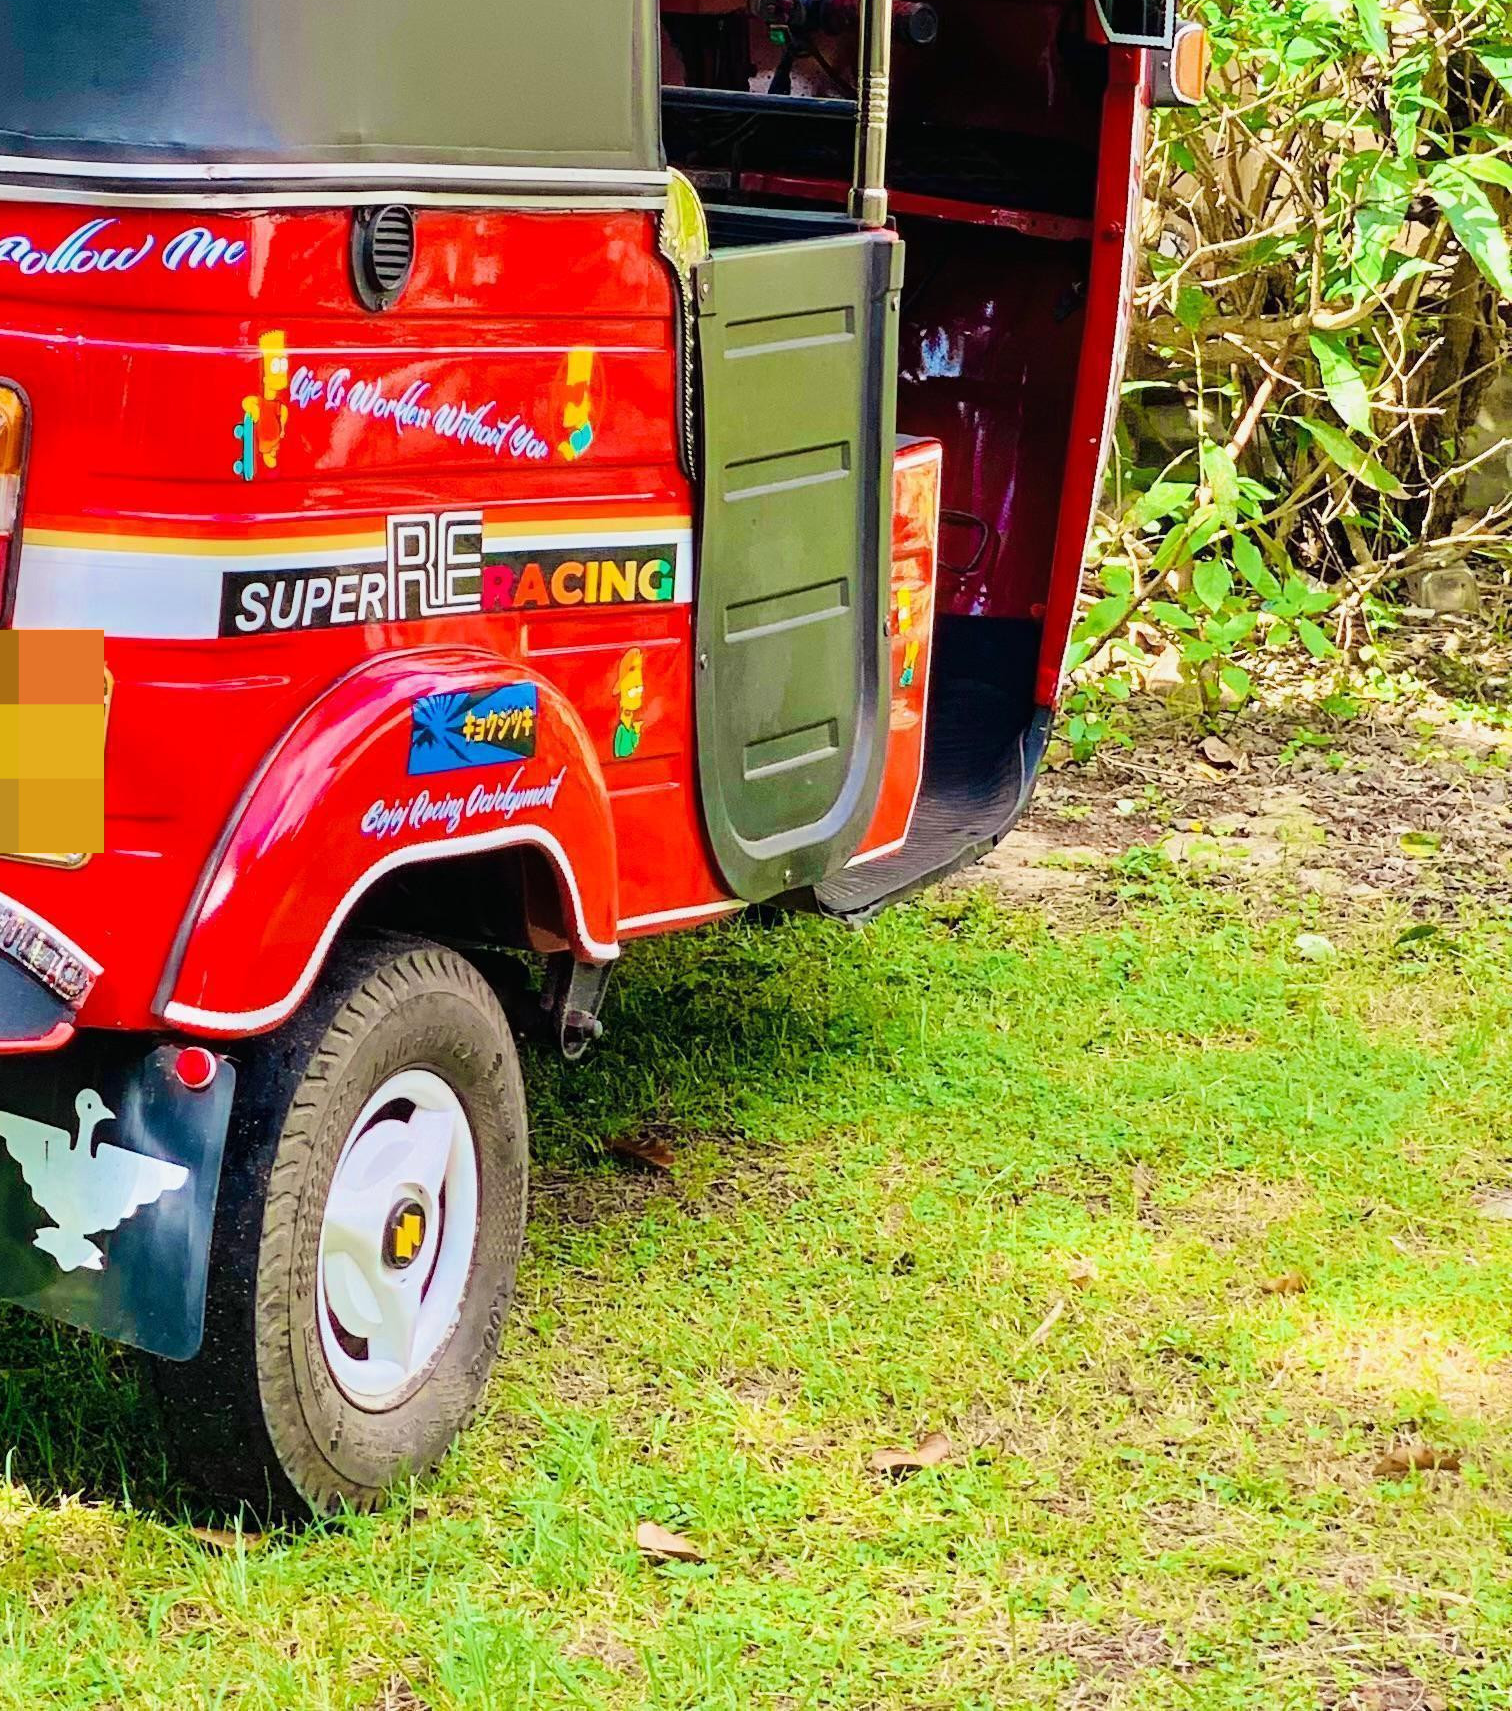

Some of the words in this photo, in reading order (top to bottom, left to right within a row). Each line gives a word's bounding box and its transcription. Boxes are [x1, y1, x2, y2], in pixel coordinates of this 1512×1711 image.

[162, 226, 246, 272] Me
[289, 365, 324, 410] Life
[431, 400, 521, 456] Without
[509, 421, 550, 459] You
[235, 571, 387, 633] SUPER
[386, 509, 484, 622] RE
[482, 558, 674, 611] RACING
[409, 790, 464, 834] Racing
